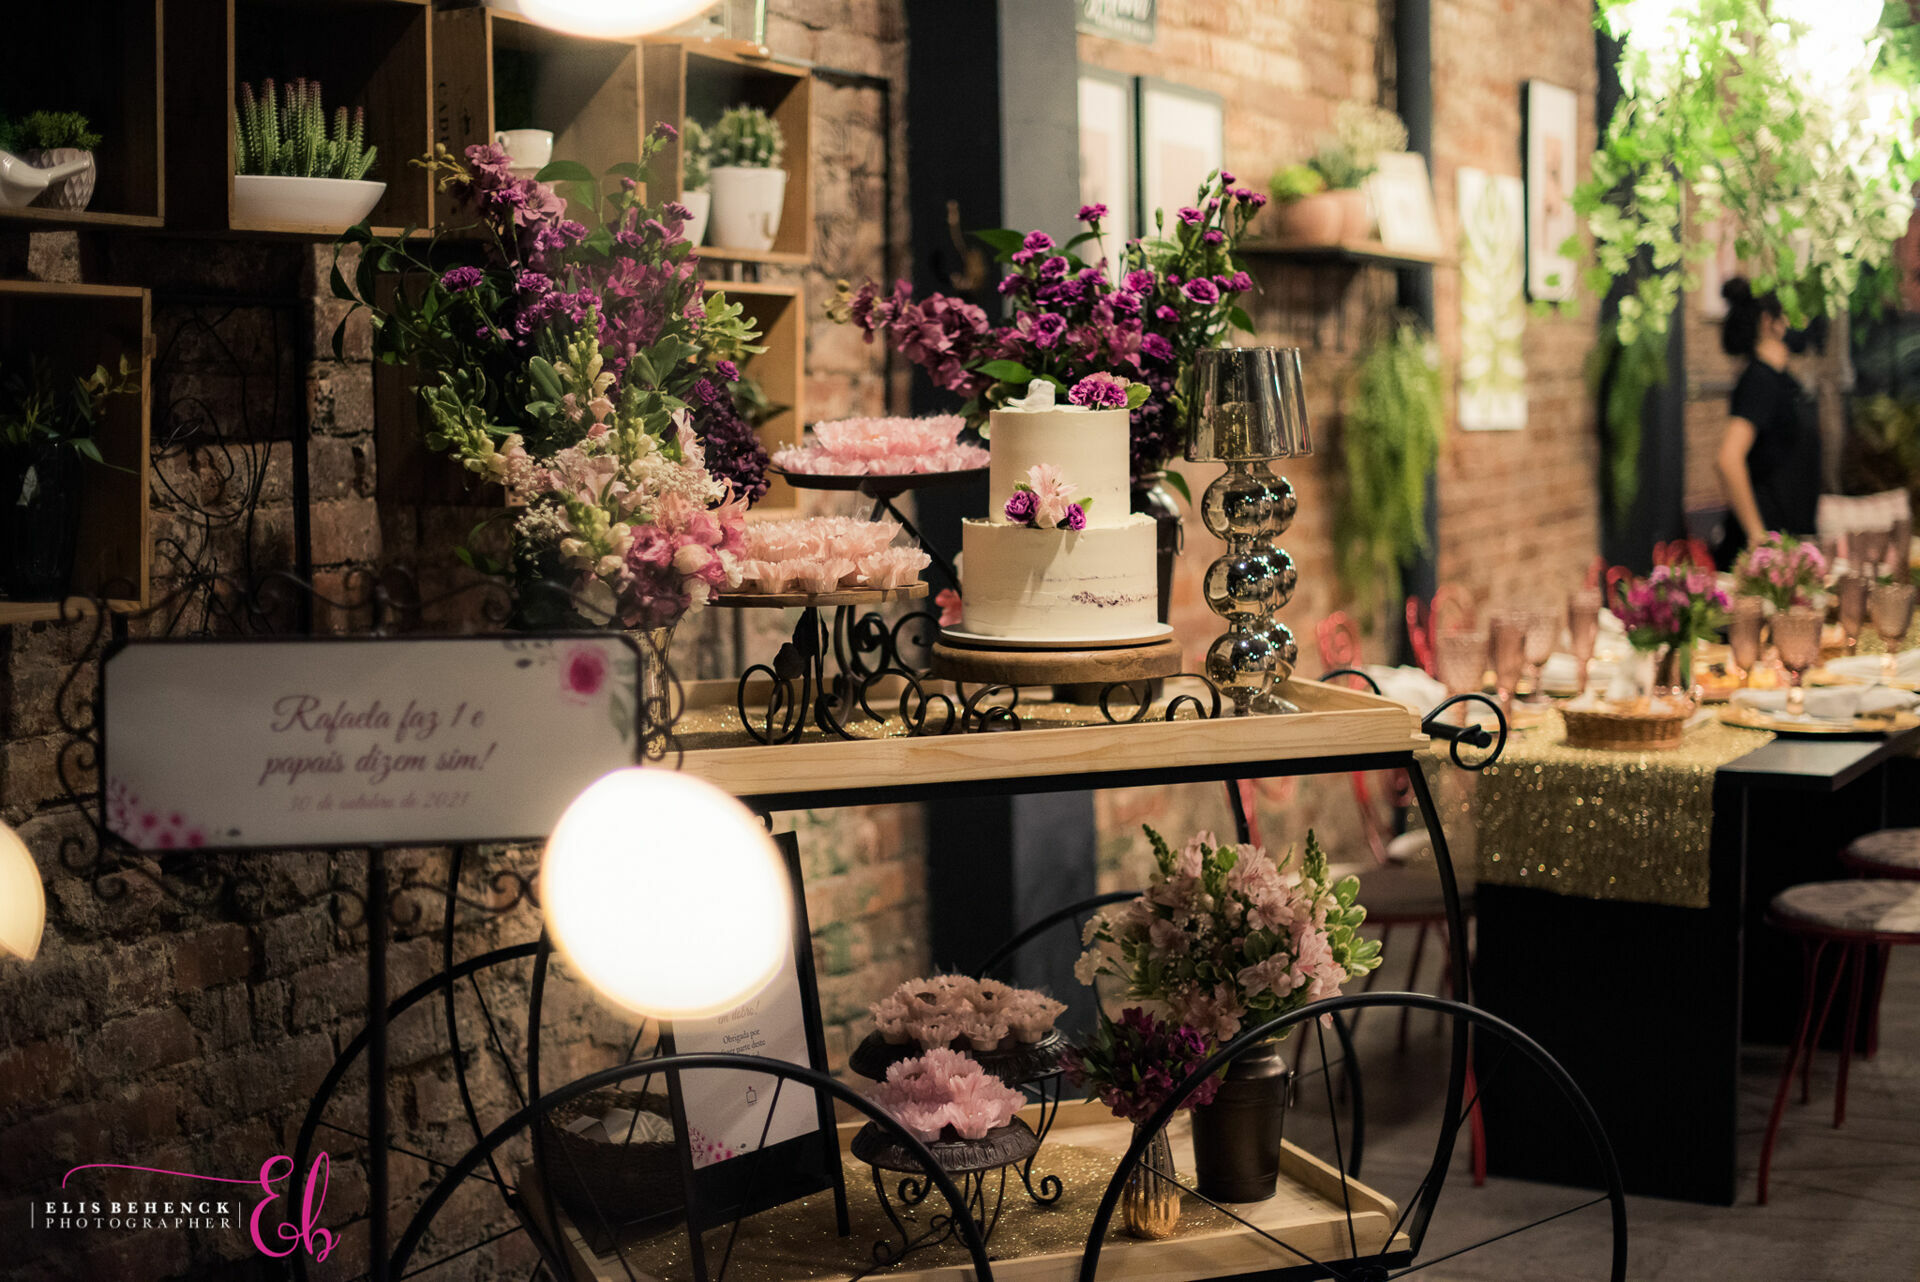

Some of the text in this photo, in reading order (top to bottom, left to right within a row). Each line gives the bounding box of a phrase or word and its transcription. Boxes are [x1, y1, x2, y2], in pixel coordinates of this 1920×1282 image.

[270, 694, 391, 744] Rafaela
[394, 698, 438, 743] faz
[471, 710, 484, 728] e
[257, 742, 497, 786] papais dizem sim!
[316, 792, 333, 811] de
[399, 790, 416, 808] de
[423, 791, 470, 809] 2021
